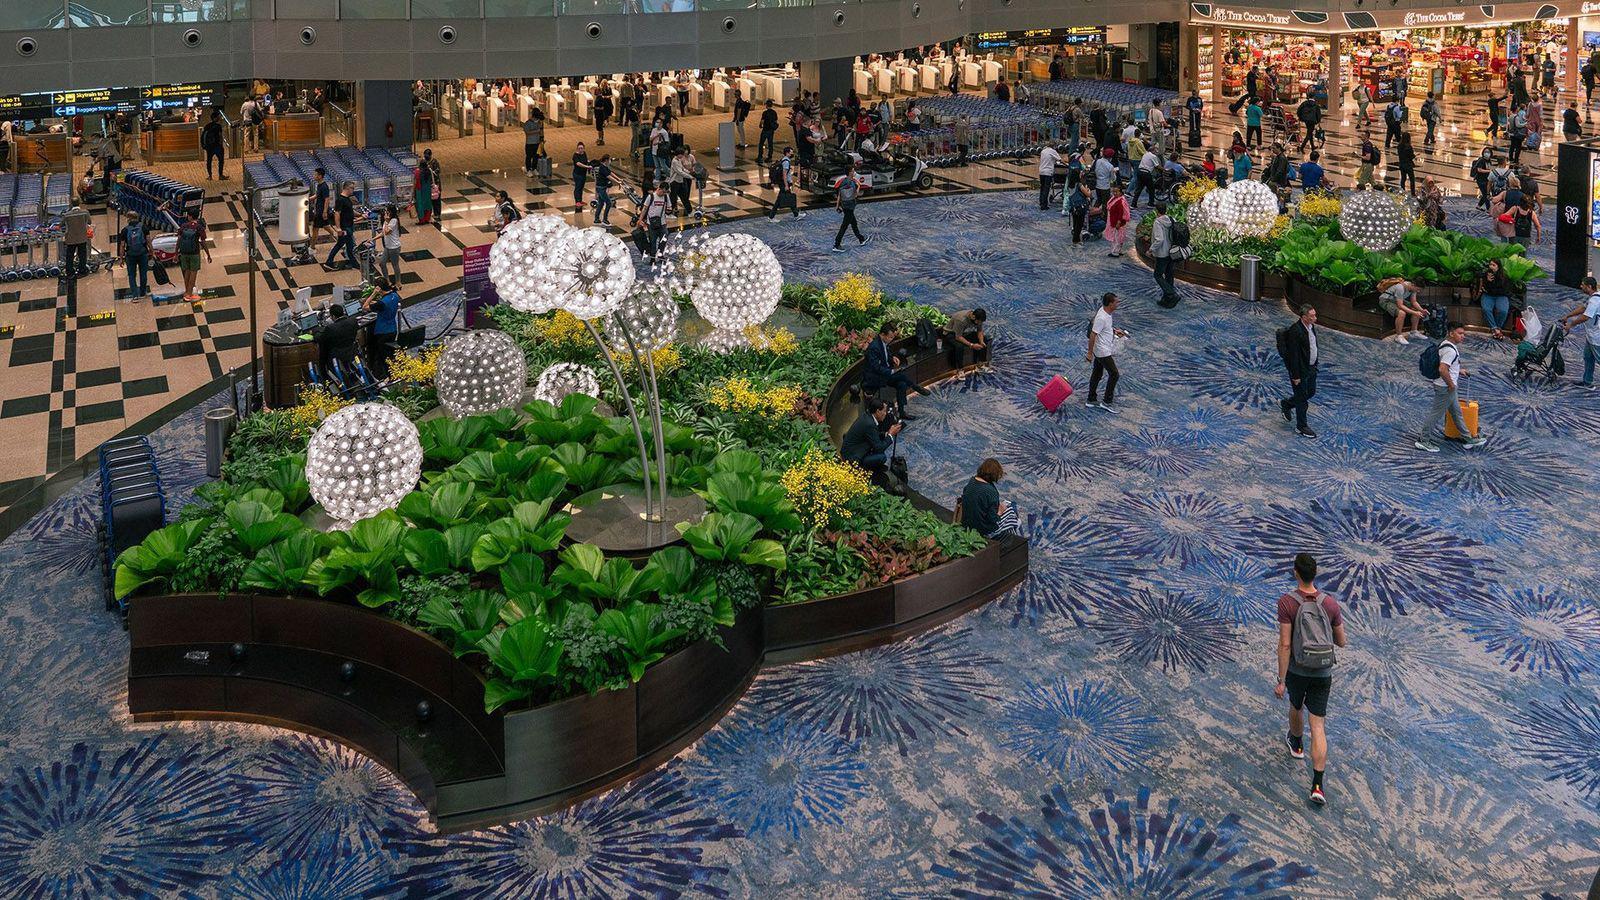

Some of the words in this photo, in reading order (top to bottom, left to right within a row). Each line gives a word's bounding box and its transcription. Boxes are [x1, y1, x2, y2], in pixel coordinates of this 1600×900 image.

[1227, 11, 1242, 20] THE
[1243, 12, 1267, 22] COCOA
[1267, 13, 1289, 24] TREES
[1416, 14, 1428, 22] THE
[1429, 12, 1447, 22] COCOA
[1447, 12, 1464, 21] TREES
